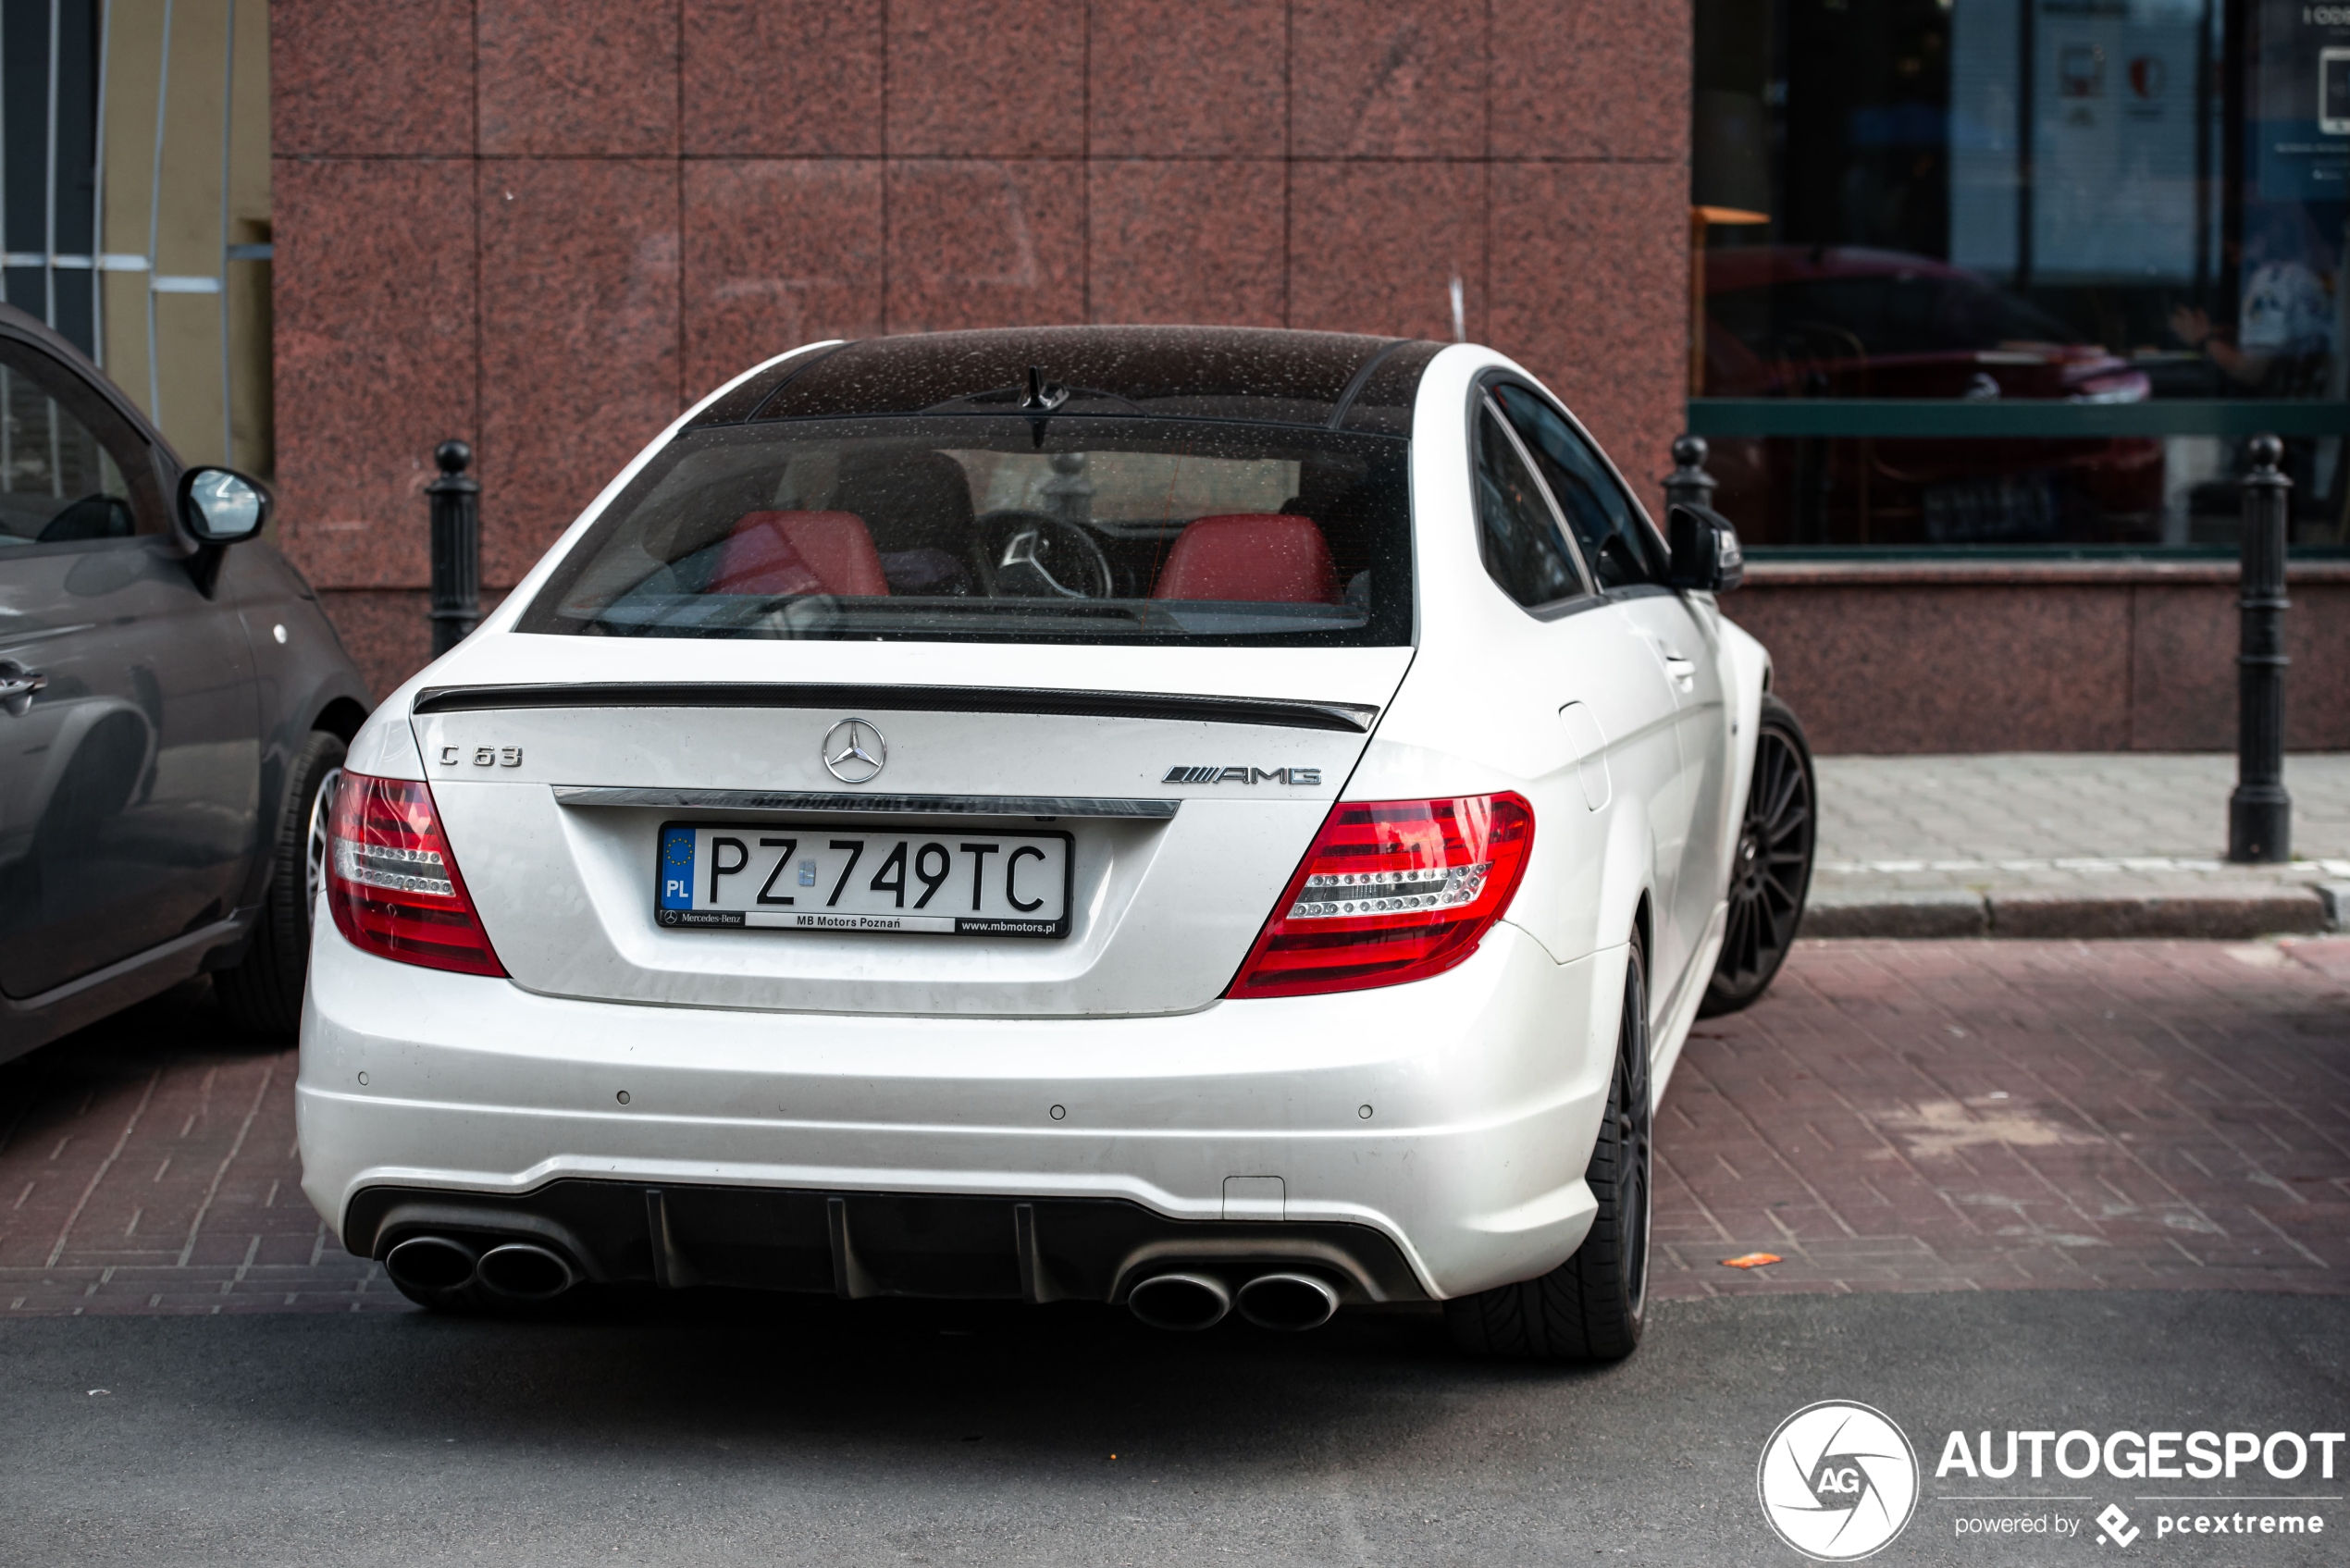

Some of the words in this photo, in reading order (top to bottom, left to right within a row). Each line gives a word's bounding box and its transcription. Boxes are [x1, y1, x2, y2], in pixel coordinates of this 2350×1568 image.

[439, 744, 459, 766] C
[473, 745, 523, 767] 63
[1212, 766, 1322, 785] AMG
[709, 836, 798, 905] PZ
[825, 839, 1046, 913] 749TC
[666, 880, 689, 898] PL
[682, 912, 741, 924] Mercedes-Benz
[797, 915, 814, 926] MB
[817, 916, 857, 927] Motors
[860, 917, 900, 929] Poznań
[961, 920, 1056, 935] www.mbmotors.pl
